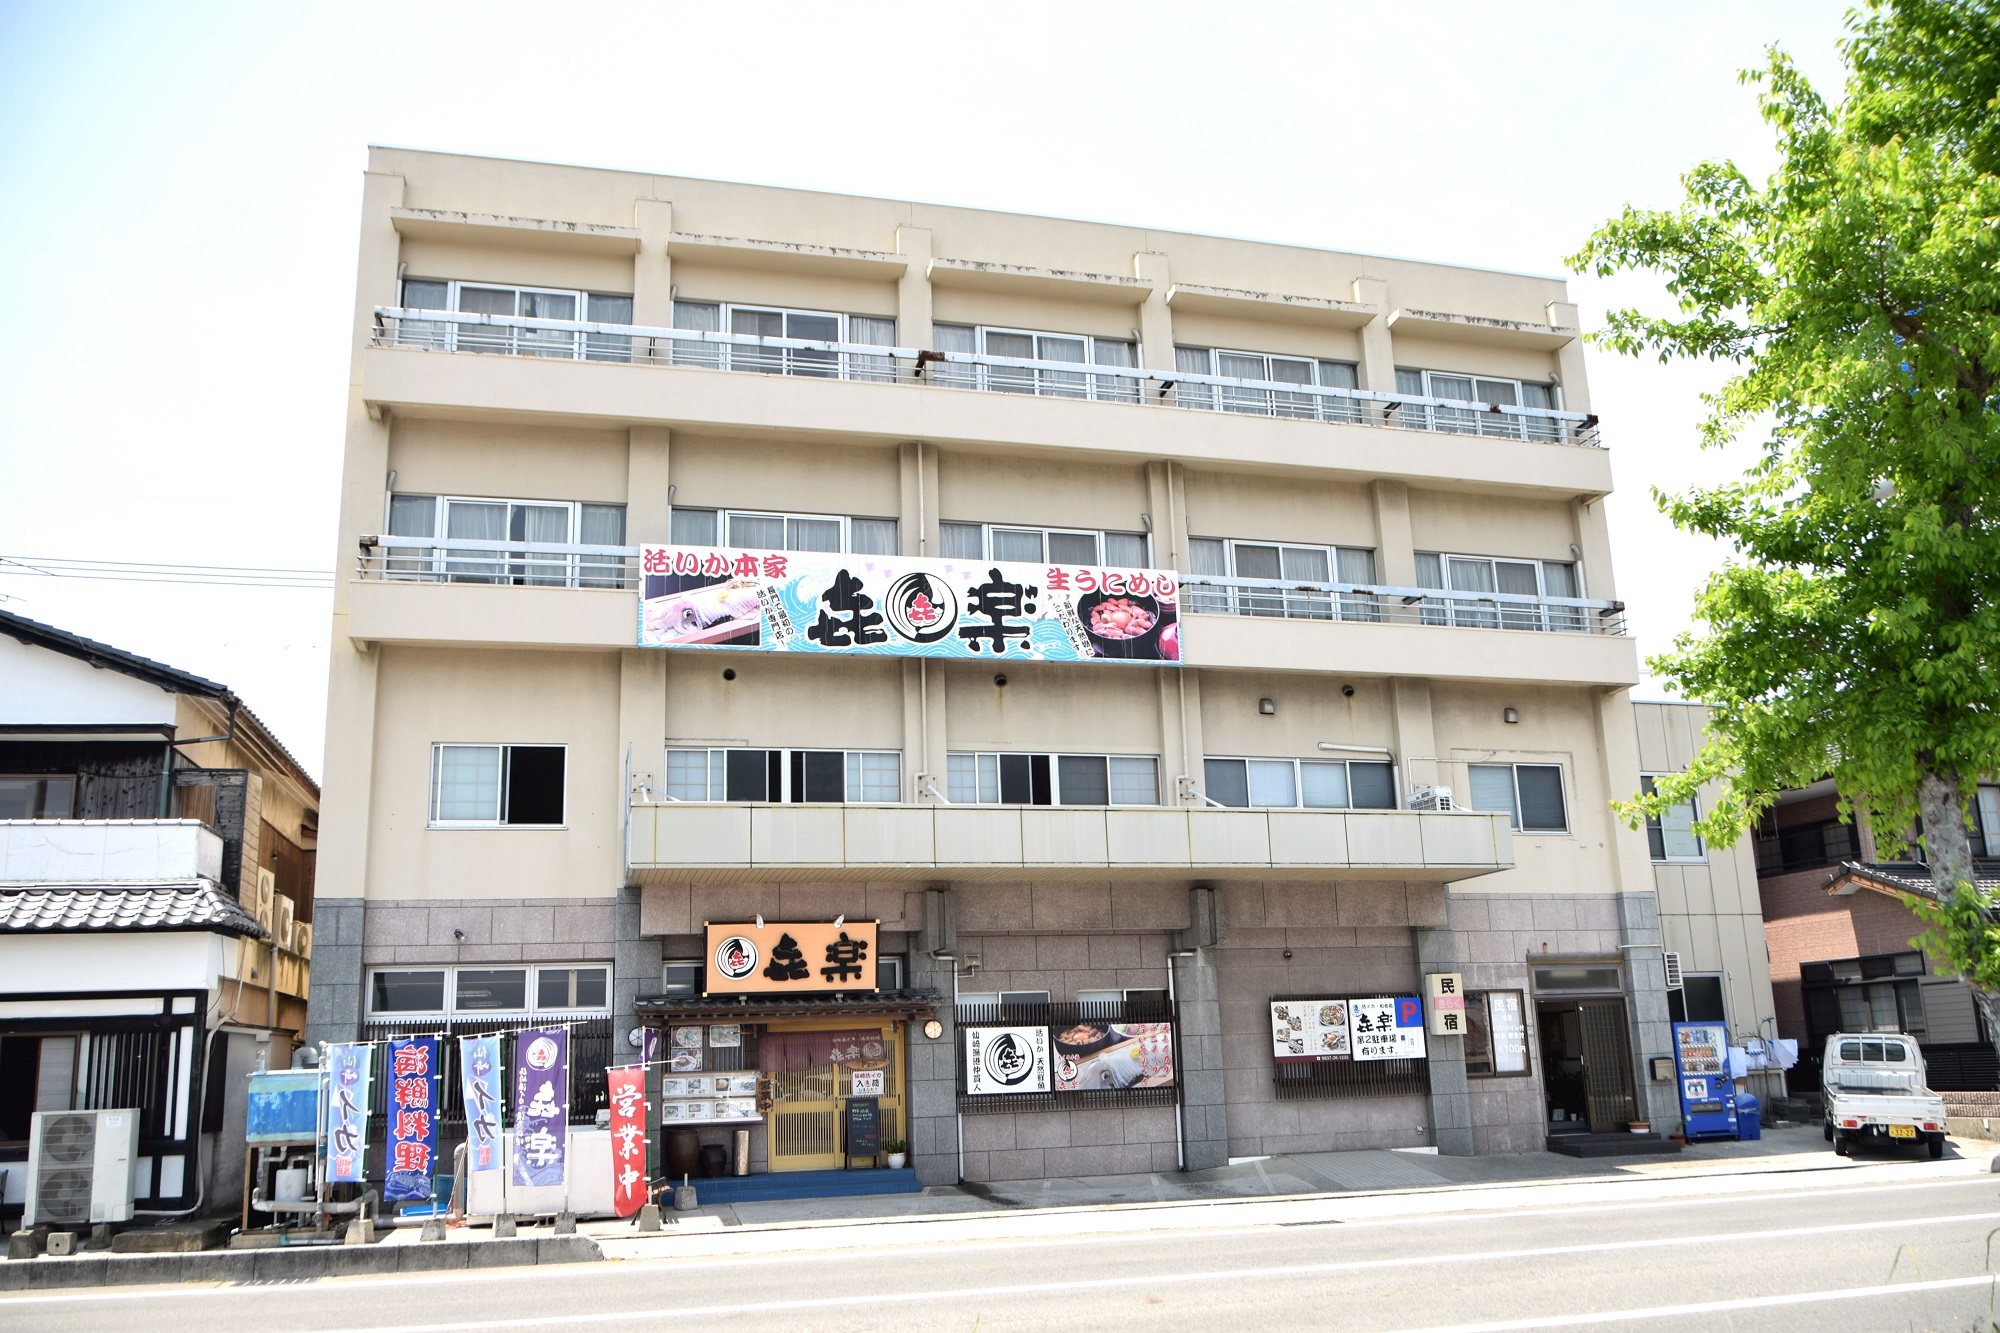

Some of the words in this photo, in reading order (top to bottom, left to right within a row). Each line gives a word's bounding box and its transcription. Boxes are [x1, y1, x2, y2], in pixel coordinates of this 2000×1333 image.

[644, 549, 788, 579] 活いか本家
[1046, 567, 1176, 596] 生うにめし
[1401, 1001, 1417, 1024] P
[1494, 998, 1517, 1012] 民宿
[1357, 1034, 1397, 1044] 第2駐車場
[612, 1084, 645, 1200] 営業中
